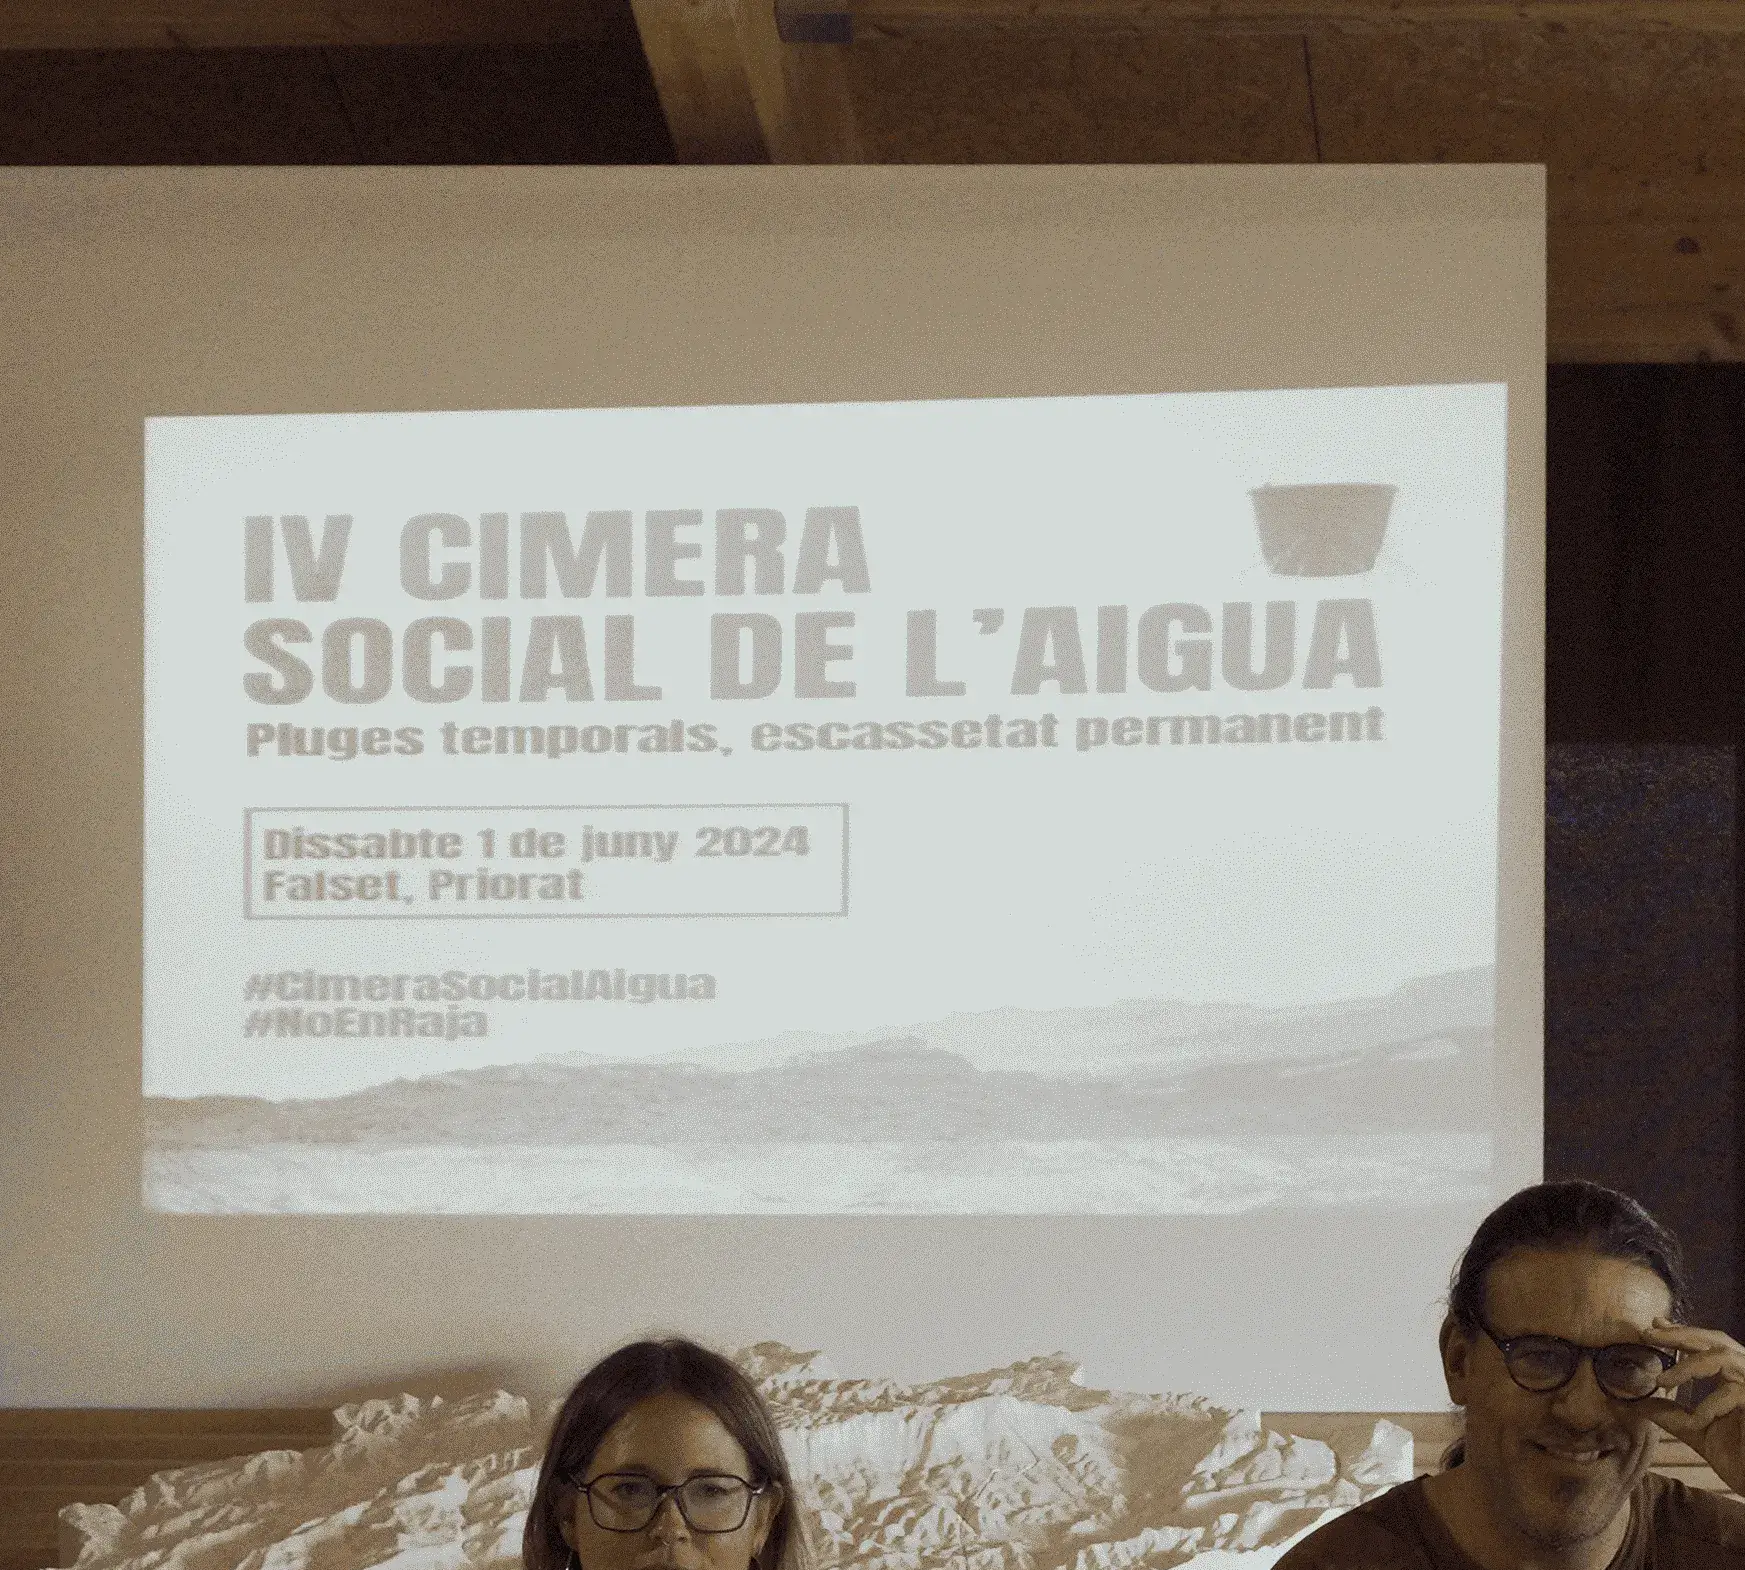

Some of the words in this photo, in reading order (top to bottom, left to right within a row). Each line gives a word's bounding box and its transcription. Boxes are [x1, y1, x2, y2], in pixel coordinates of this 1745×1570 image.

[242, 513, 355, 604] IV
[398, 504, 872, 602] CIMERA
[242, 611, 664, 706] SOCIAL
[710, 610, 858, 702] DE
[905, 596, 1384, 699] L'AIGUA
[245, 721, 426, 761] Pluges
[441, 718, 734, 760] temporals,
[749, 710, 1062, 754] escassetat
[1075, 705, 1385, 754] permanent
[263, 824, 464, 863] Dissabte
[478, 825, 497, 860] 1
[509, 824, 566, 860] de
[580, 826, 679, 864] juny
[694, 824, 810, 861] 2024
[263, 867, 413, 906] Falset,
[428, 867, 585, 902] Priorat
[243, 968, 717, 1008] #CimeraSocialAigua
[243, 1005, 489, 1042] #NoEnRaja
